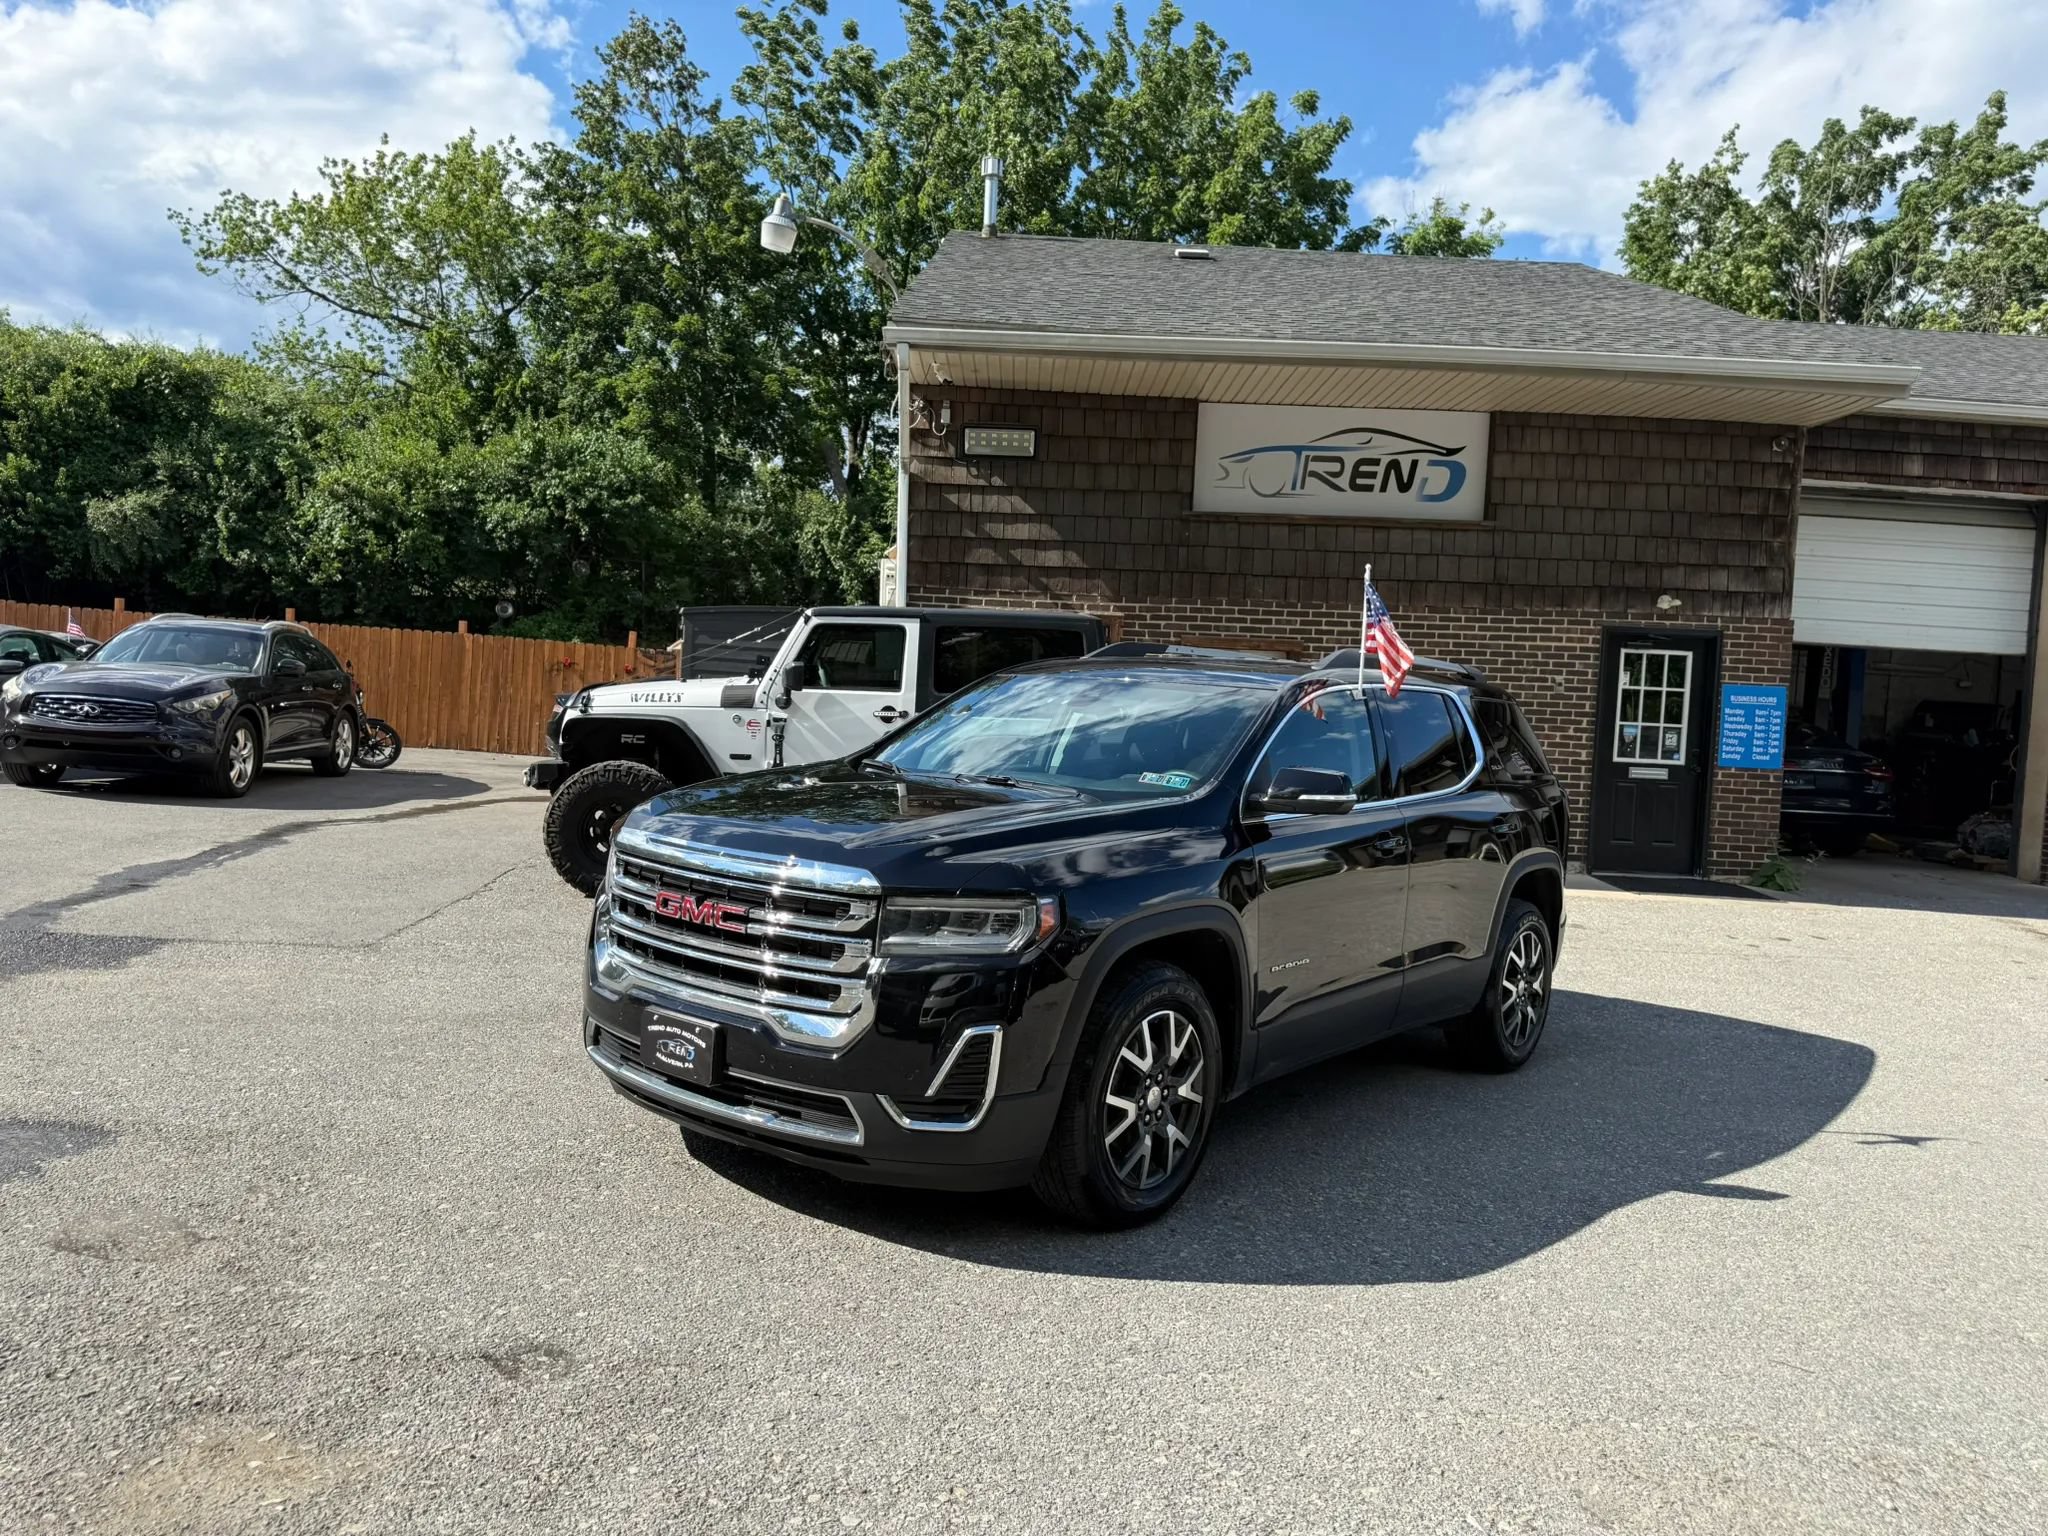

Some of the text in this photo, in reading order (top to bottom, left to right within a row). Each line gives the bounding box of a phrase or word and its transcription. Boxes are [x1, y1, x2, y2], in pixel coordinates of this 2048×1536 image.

[1290, 446, 1467, 503] TREND
[630, 692, 684, 703] WILLYS
[1724, 708, 1745, 716] Monday
[1724, 715, 1745, 723] Tuesday
[1724, 723, 1752, 731] Wednesday
[1724, 730, 1747, 738] Thursday
[621, 734, 645, 744] RC
[1722, 745, 1745, 753] Saturday
[1722, 752, 1741, 760] Sunday
[655, 890, 749, 933] GMC
[666, 1026, 681, 1034] AUTO
[682, 1030, 706, 1048] MOTORS
